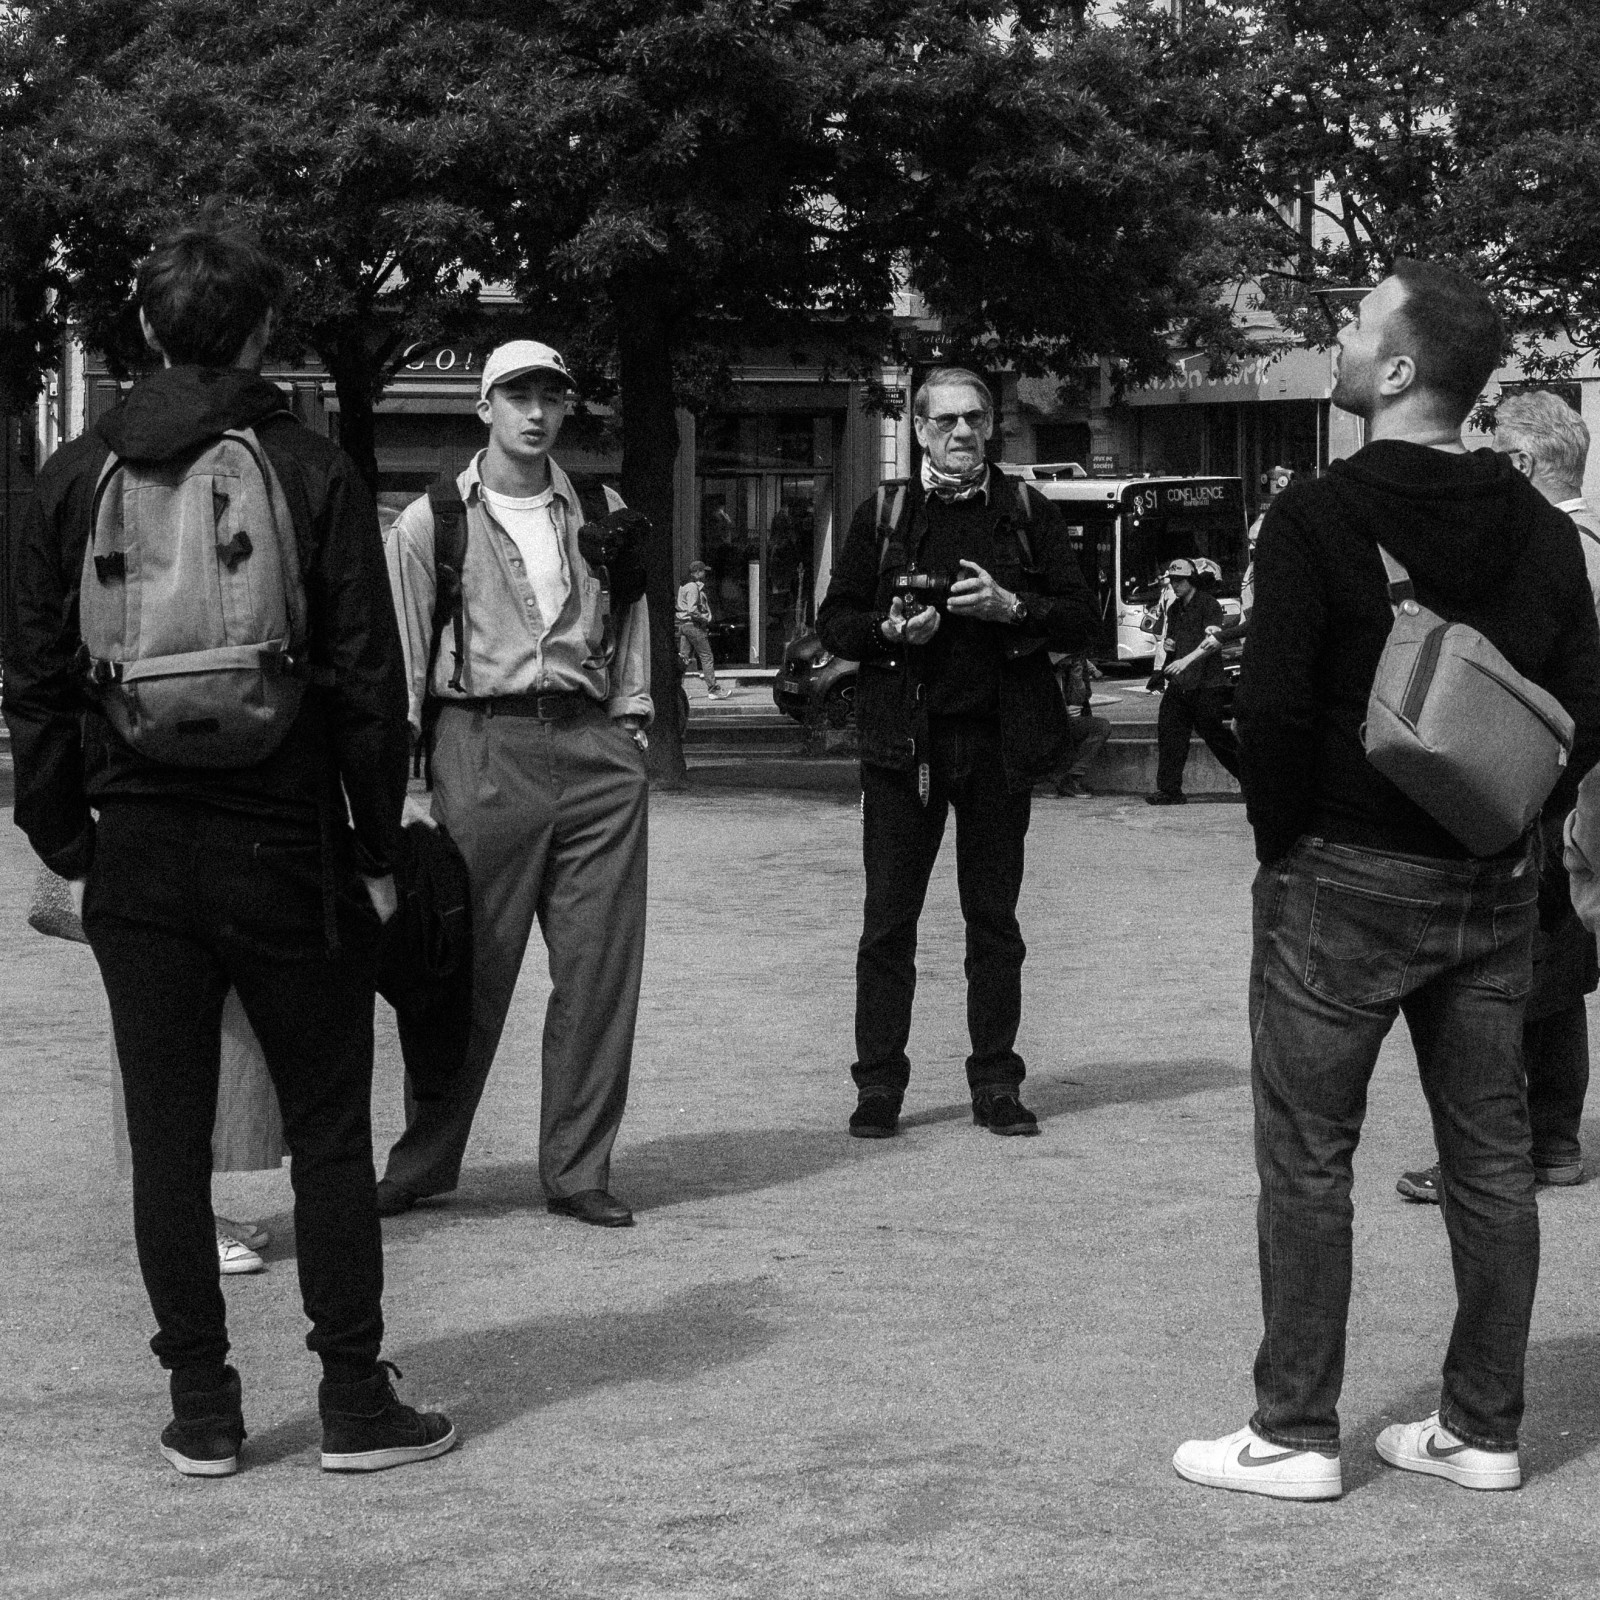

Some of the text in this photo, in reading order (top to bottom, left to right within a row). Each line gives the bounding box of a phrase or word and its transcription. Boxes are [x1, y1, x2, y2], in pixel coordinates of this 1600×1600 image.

[917, 333, 957, 344] otéla
[1145, 486, 1224, 509] S1 CONFLUENCE
